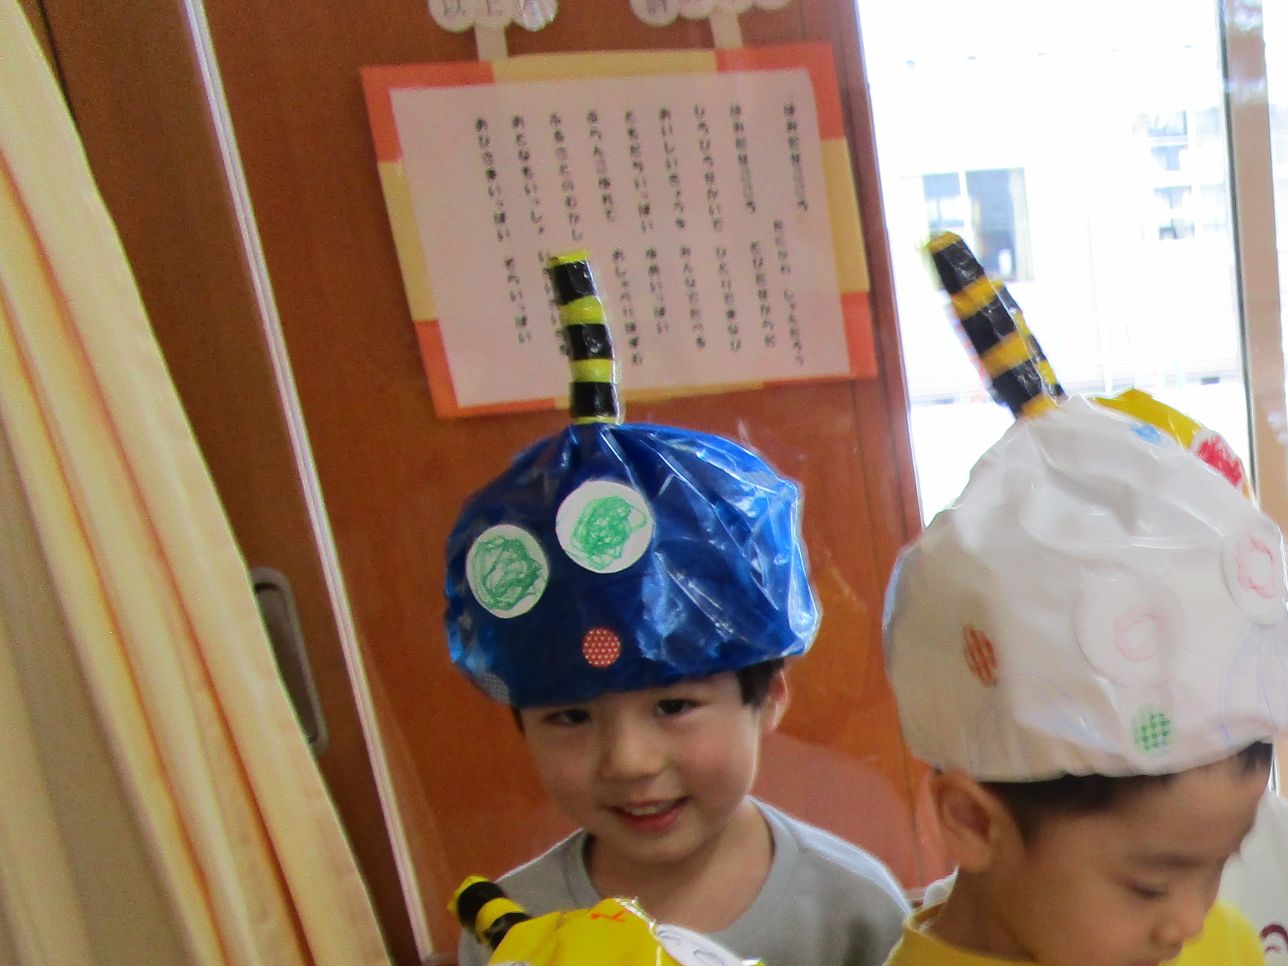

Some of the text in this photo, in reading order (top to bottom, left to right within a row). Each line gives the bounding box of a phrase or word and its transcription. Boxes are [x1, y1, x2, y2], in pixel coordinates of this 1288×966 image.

[625, 111, 652, 232] ともだちいっぱい
